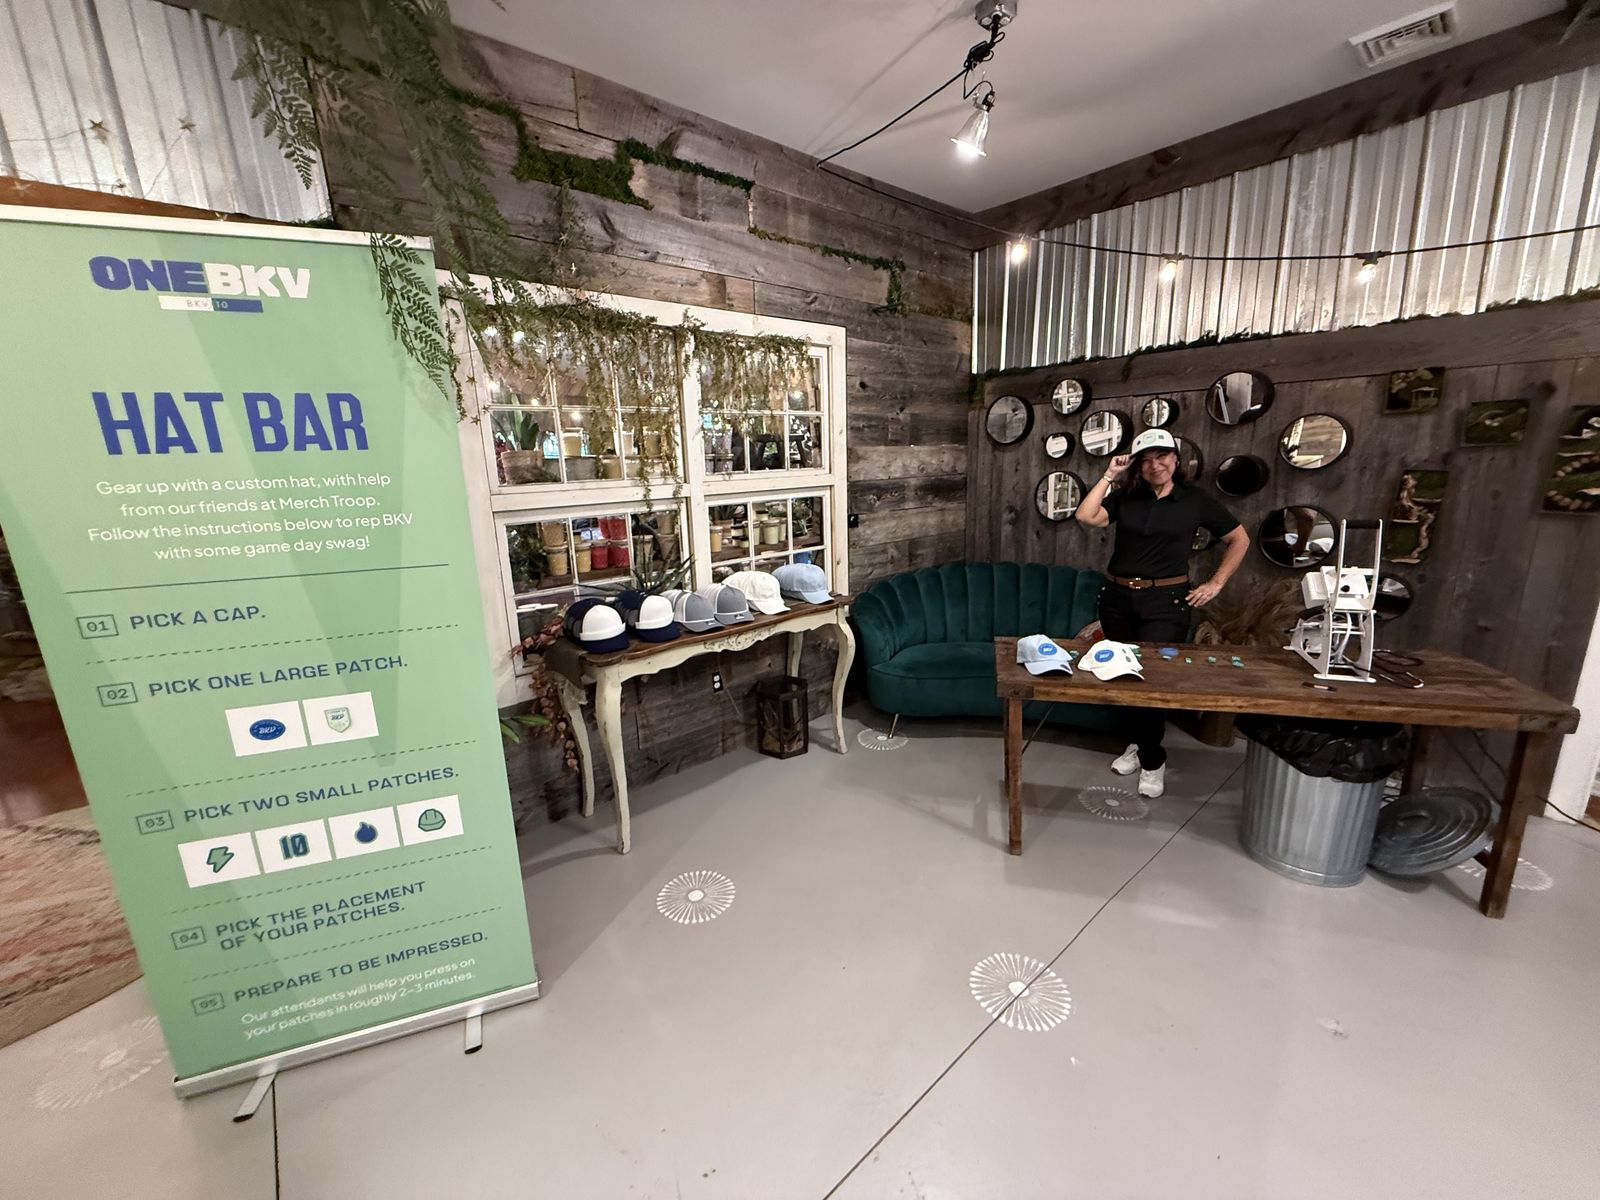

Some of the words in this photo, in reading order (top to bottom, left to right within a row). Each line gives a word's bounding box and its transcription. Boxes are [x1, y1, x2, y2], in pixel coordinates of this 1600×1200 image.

[92, 392, 224, 455] HAT
[242, 392, 369, 453] BAR
[96, 481, 142, 495] Gear
[145, 481, 169, 495] up
[171, 478, 209, 492] with
[211, 480, 222, 491] a
[224, 477, 288, 490] custom
[290, 475, 321, 488] hat,
[322, 473, 357, 487] with
[358, 473, 391, 487] help
[120, 504, 165, 517] from
[168, 504, 196, 515] our
[199, 500, 258, 514] friends
[260, 499, 278, 511] at
[279, 496, 330, 511] Merch
[331, 495, 381, 508] Troop.
[88, 527, 150, 542] Follow
[152, 525, 182, 538] the
[184, 520, 282, 536] instructions
[284, 517, 333, 531] below
[335, 517, 352, 528] to
[355, 516, 381, 528] rep
[383, 513, 413, 526] BKV
[154, 546, 192, 560] with
[194, 545, 242, 558] some
[244, 543, 291, 558] game
[293, 539, 323, 553] day
[325, 535, 370, 550] swag!
[86, 621, 109, 632] 01
[129, 611, 185, 630] PICK
[192, 610, 208, 625] A
[213, 605, 267, 623] CAP.
[106, 688, 129, 700] 02
[148, 678, 202, 697] PICK
[207, 672, 254, 690] ONE
[259, 664, 330, 684] LARGE
[335, 655, 408, 675] PATCH.
[145, 817, 166, 829] 03
[184, 803, 233, 822] PICK
[238, 794, 290, 813] TWO
[296, 784, 363, 804] SMALL
[367, 767, 460, 792] PATCHES.
[279, 832, 310, 861] 10
[179, 932, 199, 944] 04
[215, 917, 262, 936] PICK
[266, 906, 308, 925] THE
[312, 881, 426, 916] PLACEMENT
[220, 935, 247, 951] OF
[253, 922, 309, 943] YOUR
[313, 901, 405, 930] PATCHES.
[234, 971, 322, 1002] PREPARE
[327, 964, 353, 979] TO
[358, 957, 381, 972] BE
[386, 931, 488, 964] IMPRESSED.
[241, 1011, 268, 1025] Our
[270, 990, 346, 1018] attendants
[346, 983, 367, 998] will
[368, 976, 398, 992] help
[399, 972, 423, 987] you
[423, 963, 459, 979] press
[459, 958, 476, 968] on
[243, 1023, 279, 1041] your
[279, 1008, 335, 1032] patches
[335, 1004, 348, 1015] in
[348, 991, 397, 1011] roughly
[424, 970, 476, 991] minutes.
